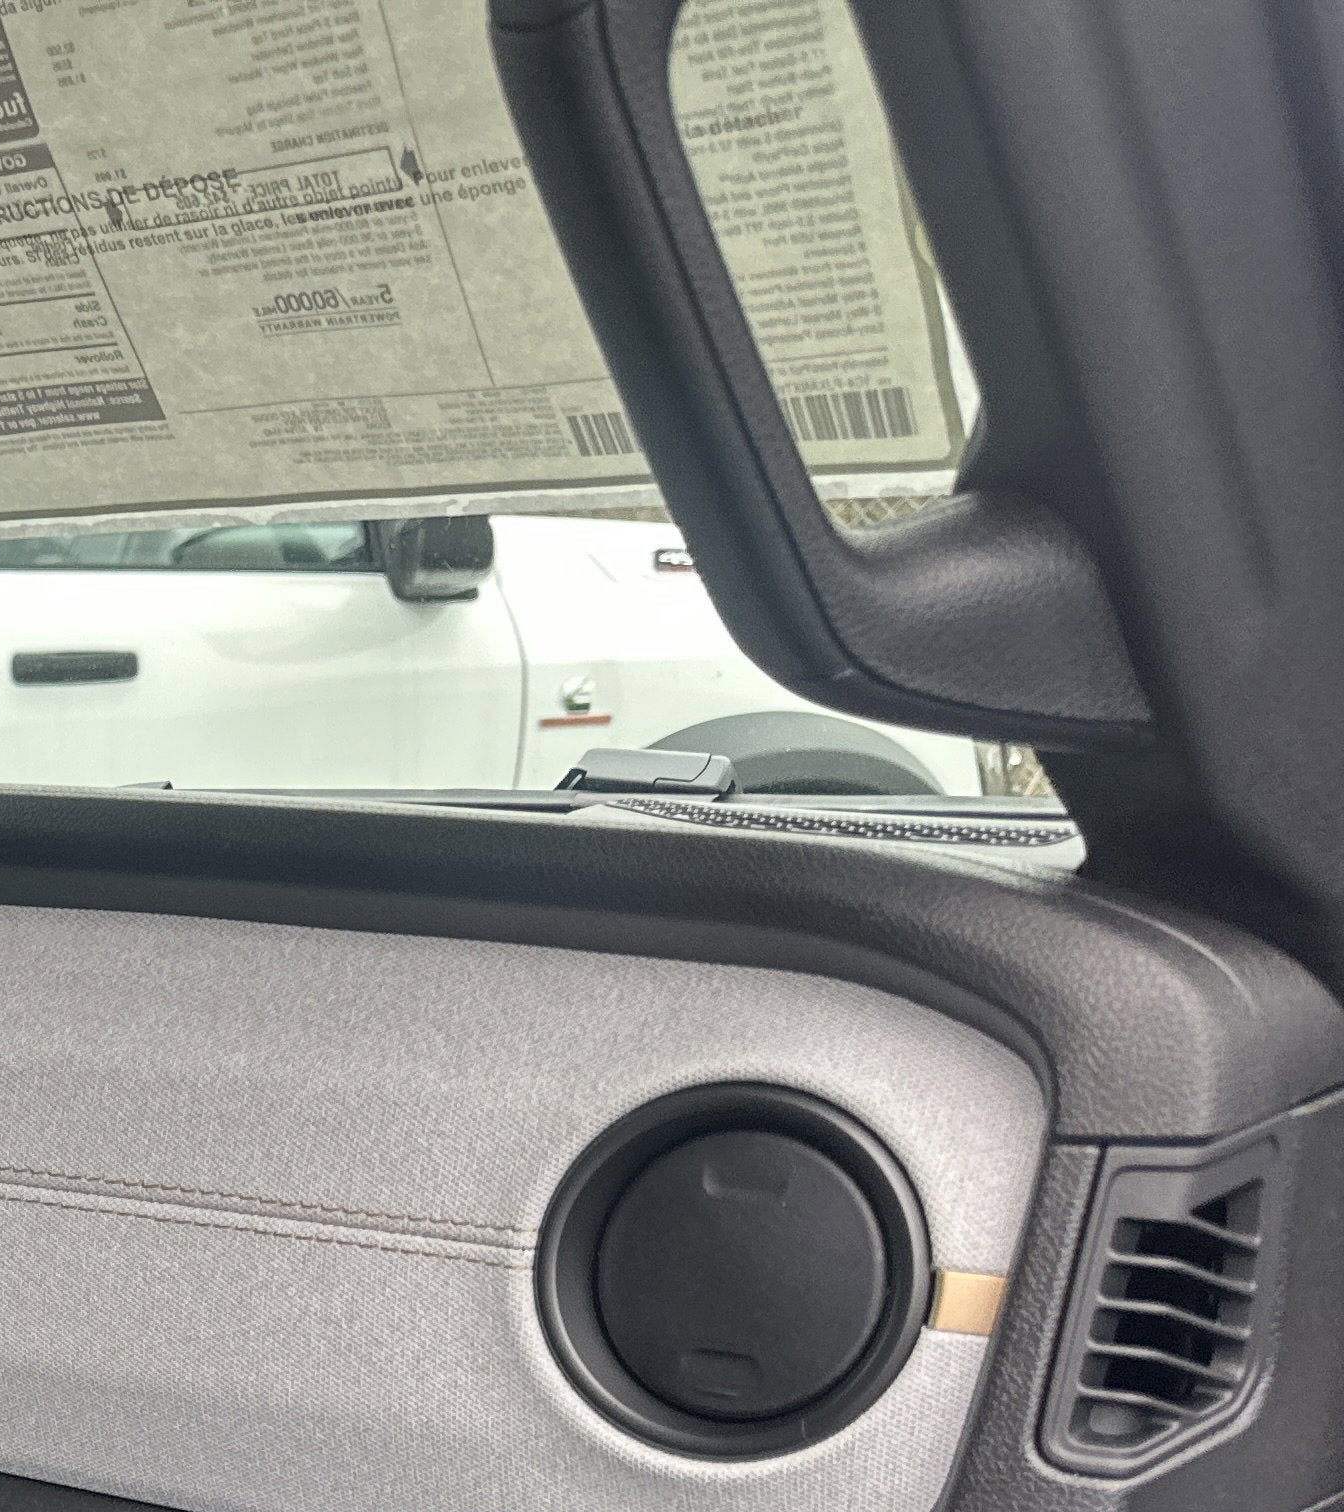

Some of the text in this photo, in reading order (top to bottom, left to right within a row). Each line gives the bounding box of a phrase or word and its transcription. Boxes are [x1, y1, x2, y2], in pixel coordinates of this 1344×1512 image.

[143, 165, 241, 200] DÉPOSE
[128, 228, 181, 249] restent
[185, 226, 209, 241] sur
[212, 220, 227, 237] la
[230, 214, 280, 237] glace,
[419, 189, 453, 206] une
[456, 175, 528, 204] éponge
